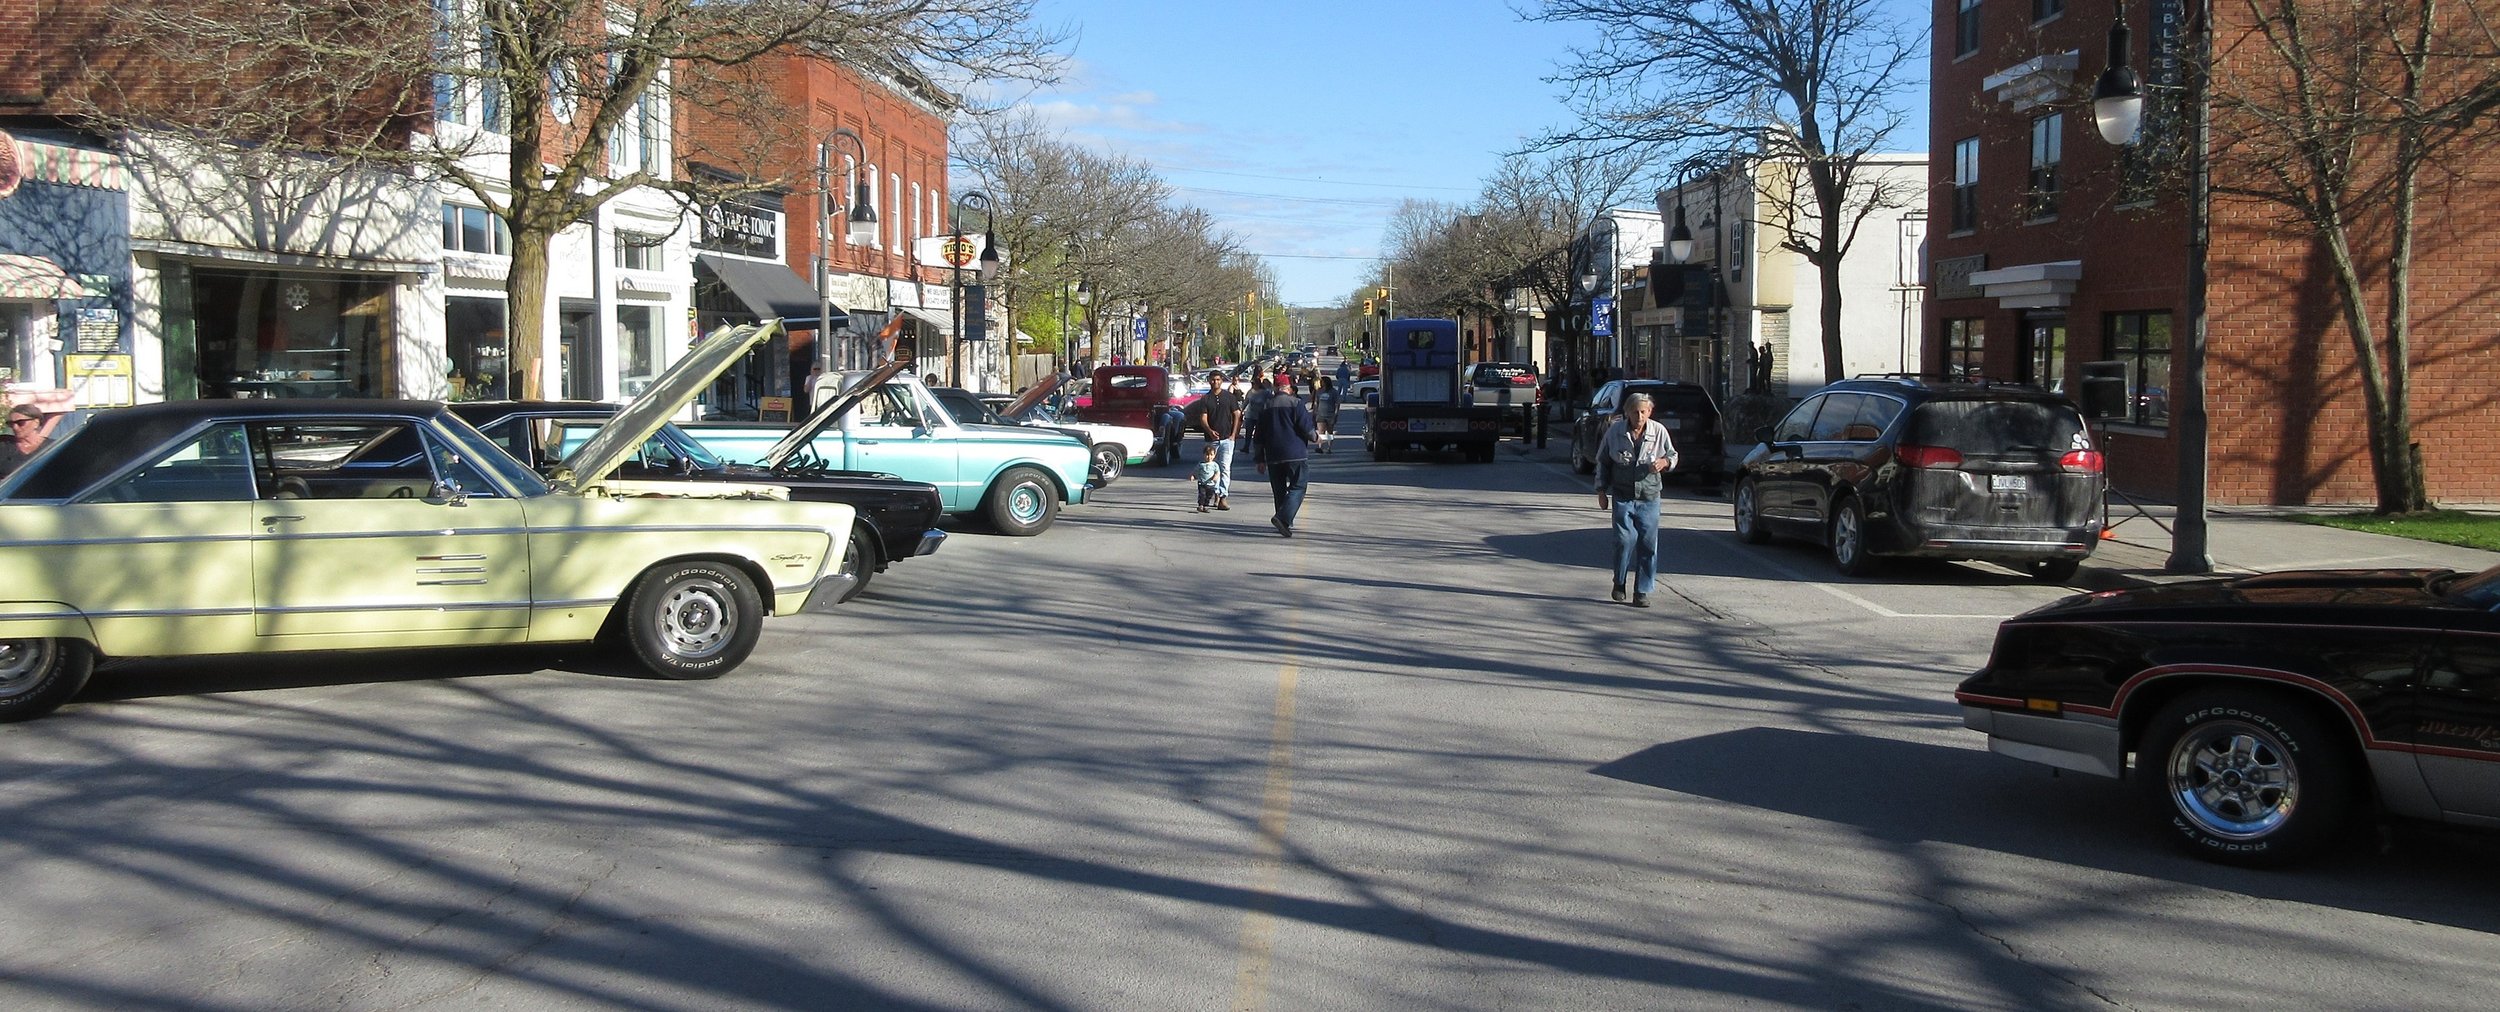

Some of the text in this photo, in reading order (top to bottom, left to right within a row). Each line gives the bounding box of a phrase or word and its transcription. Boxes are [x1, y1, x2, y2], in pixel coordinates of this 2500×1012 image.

[750, 216, 776, 239] TONIC
[944, 242, 974, 255] THO'S
[665, 568, 738, 591] BFGoodrich
[660, 652, 724, 669] Radial T/A
[2184, 707, 2299, 752] BFGoodrich
[2173, 816, 2268, 851] Radial T/A
